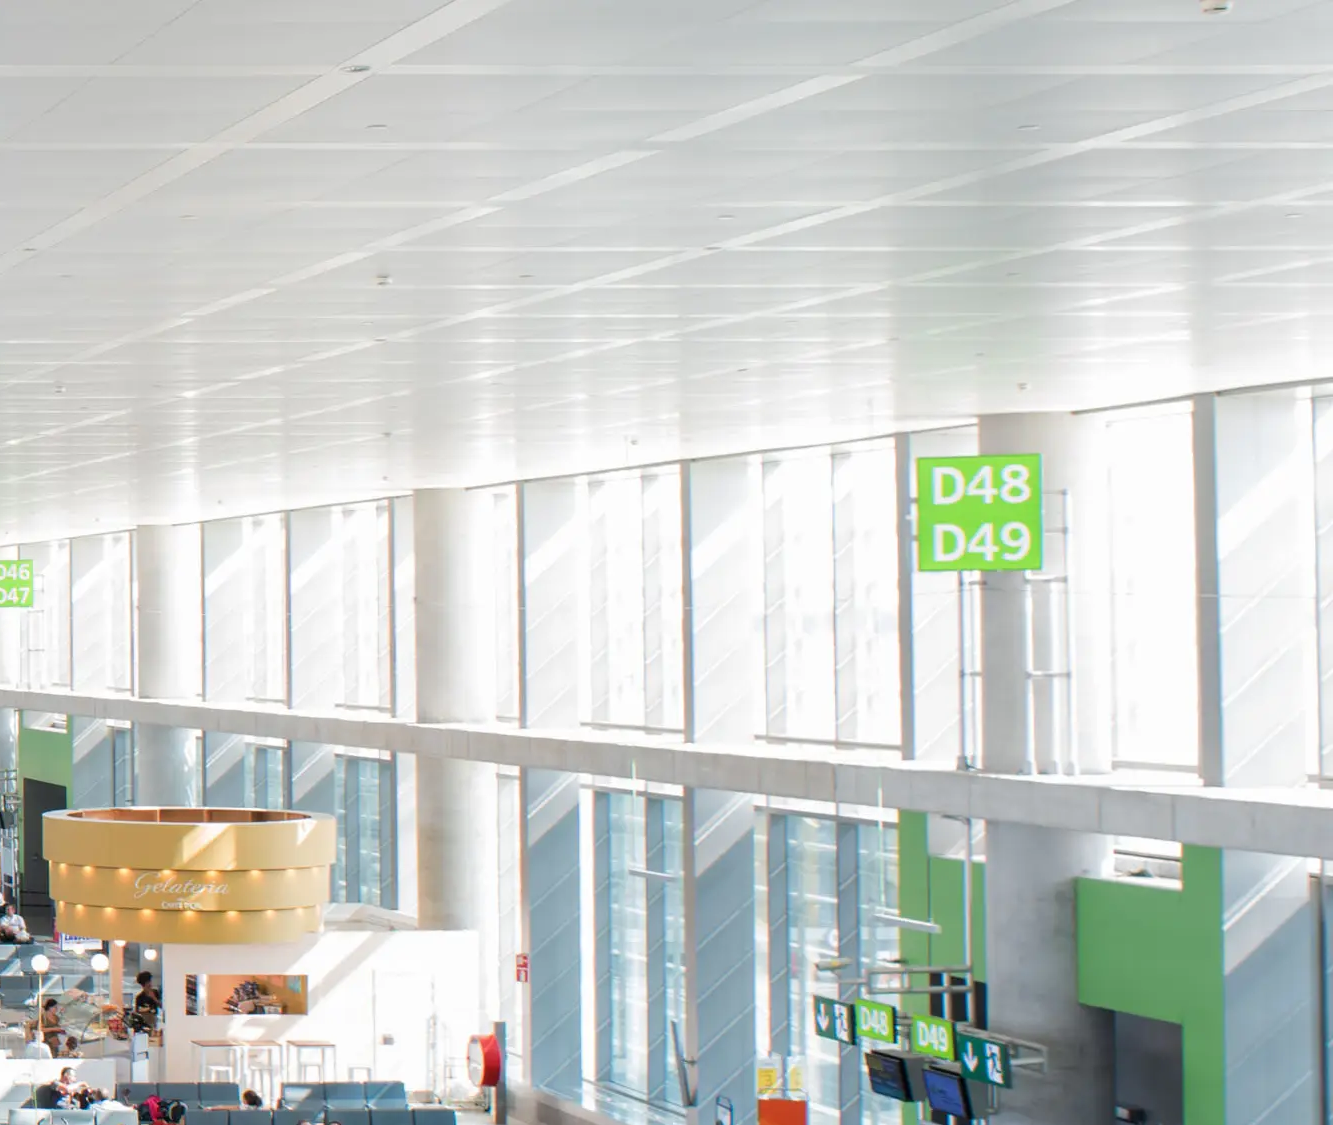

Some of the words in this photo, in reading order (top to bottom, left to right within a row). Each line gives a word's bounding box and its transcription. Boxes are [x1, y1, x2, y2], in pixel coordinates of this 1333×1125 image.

[931, 464, 1031, 505] D48
[932, 522, 1031, 562] D49
[134, 872, 229, 899] Gelateria
[860, 1005, 889, 1037] D48
[916, 1020, 949, 1053] D49
